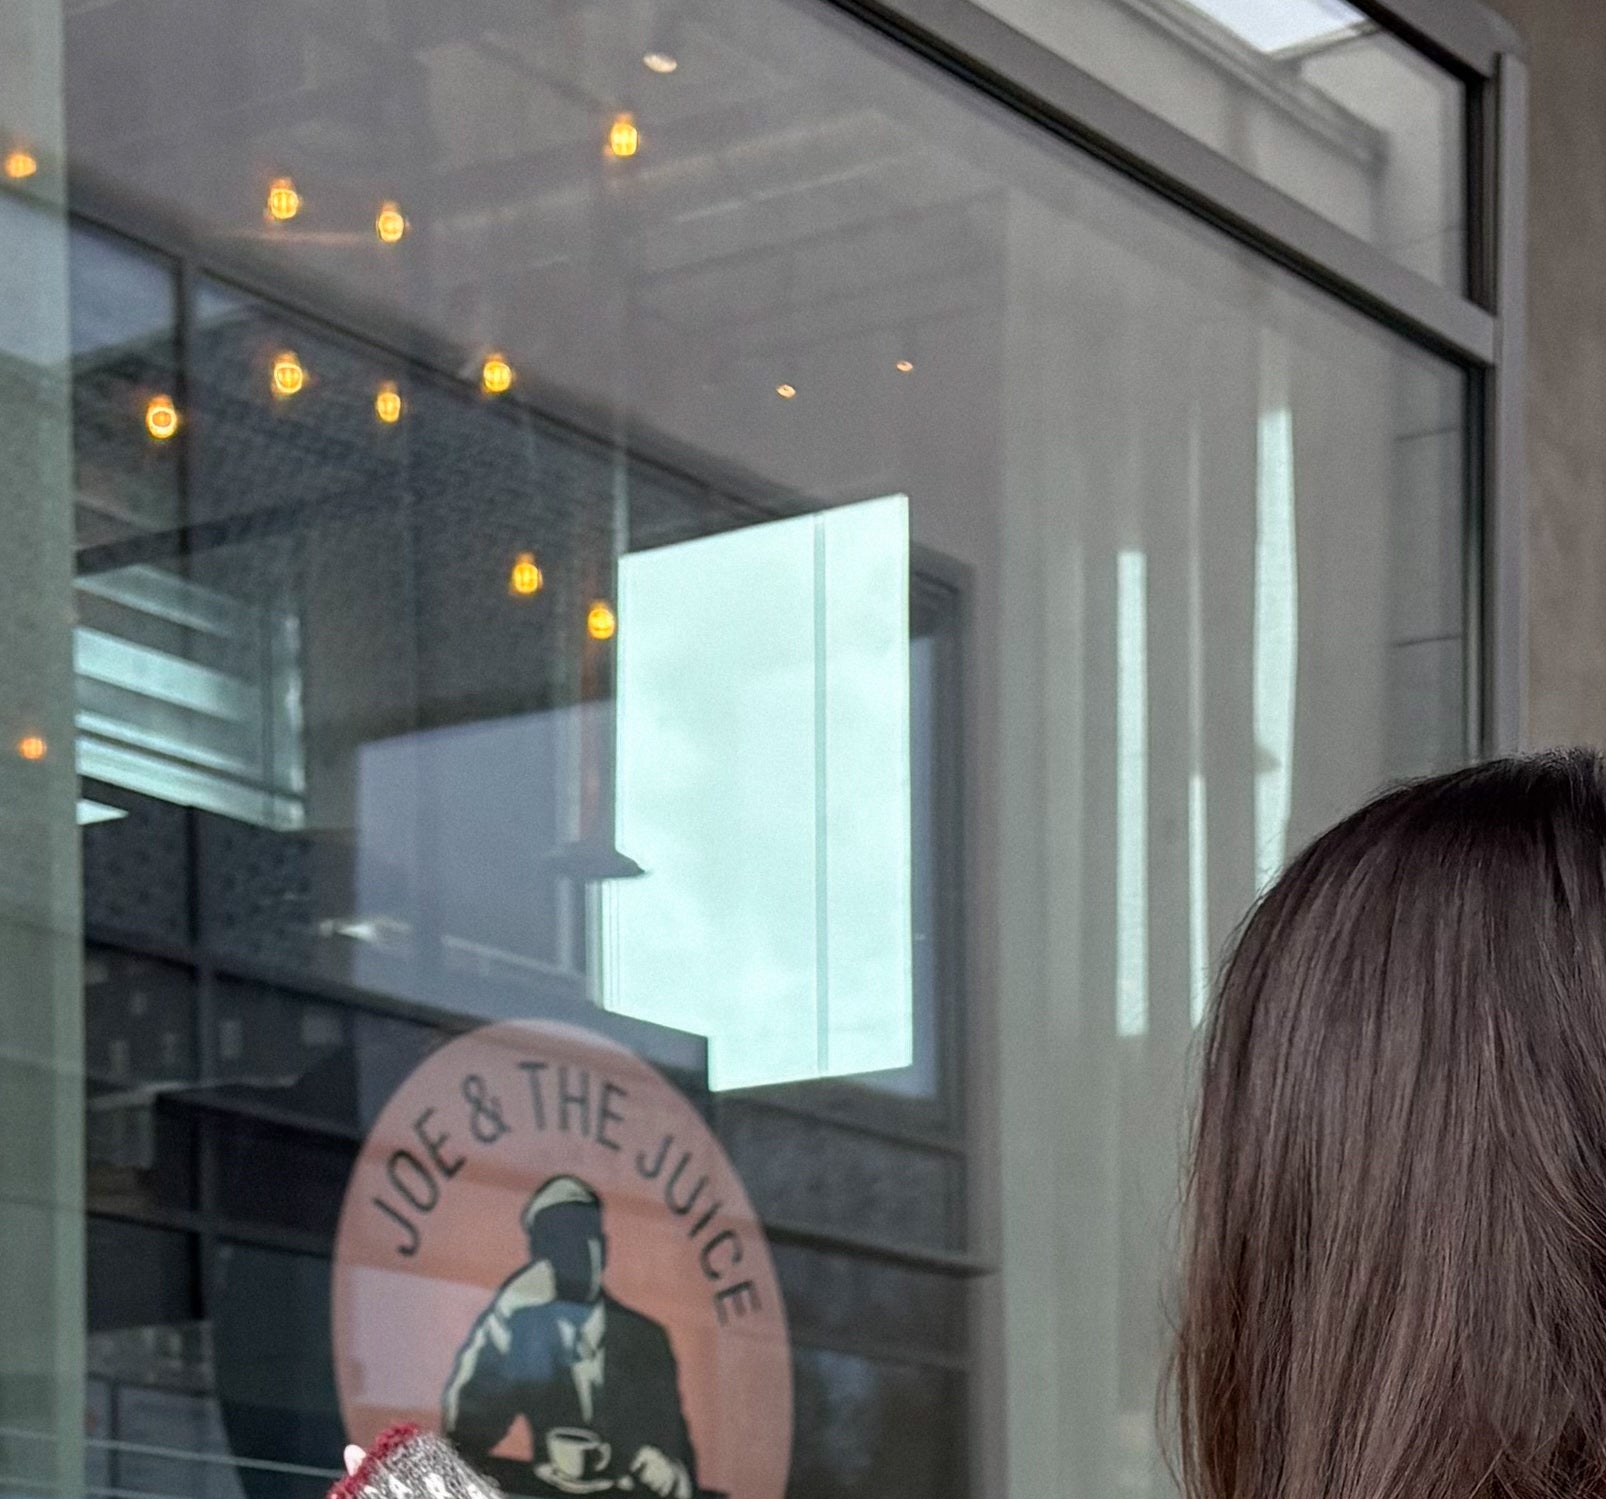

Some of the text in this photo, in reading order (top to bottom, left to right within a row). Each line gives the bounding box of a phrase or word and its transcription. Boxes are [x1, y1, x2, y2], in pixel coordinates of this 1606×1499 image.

[372, 1060, 765, 1328] JOE & THE JUICE
